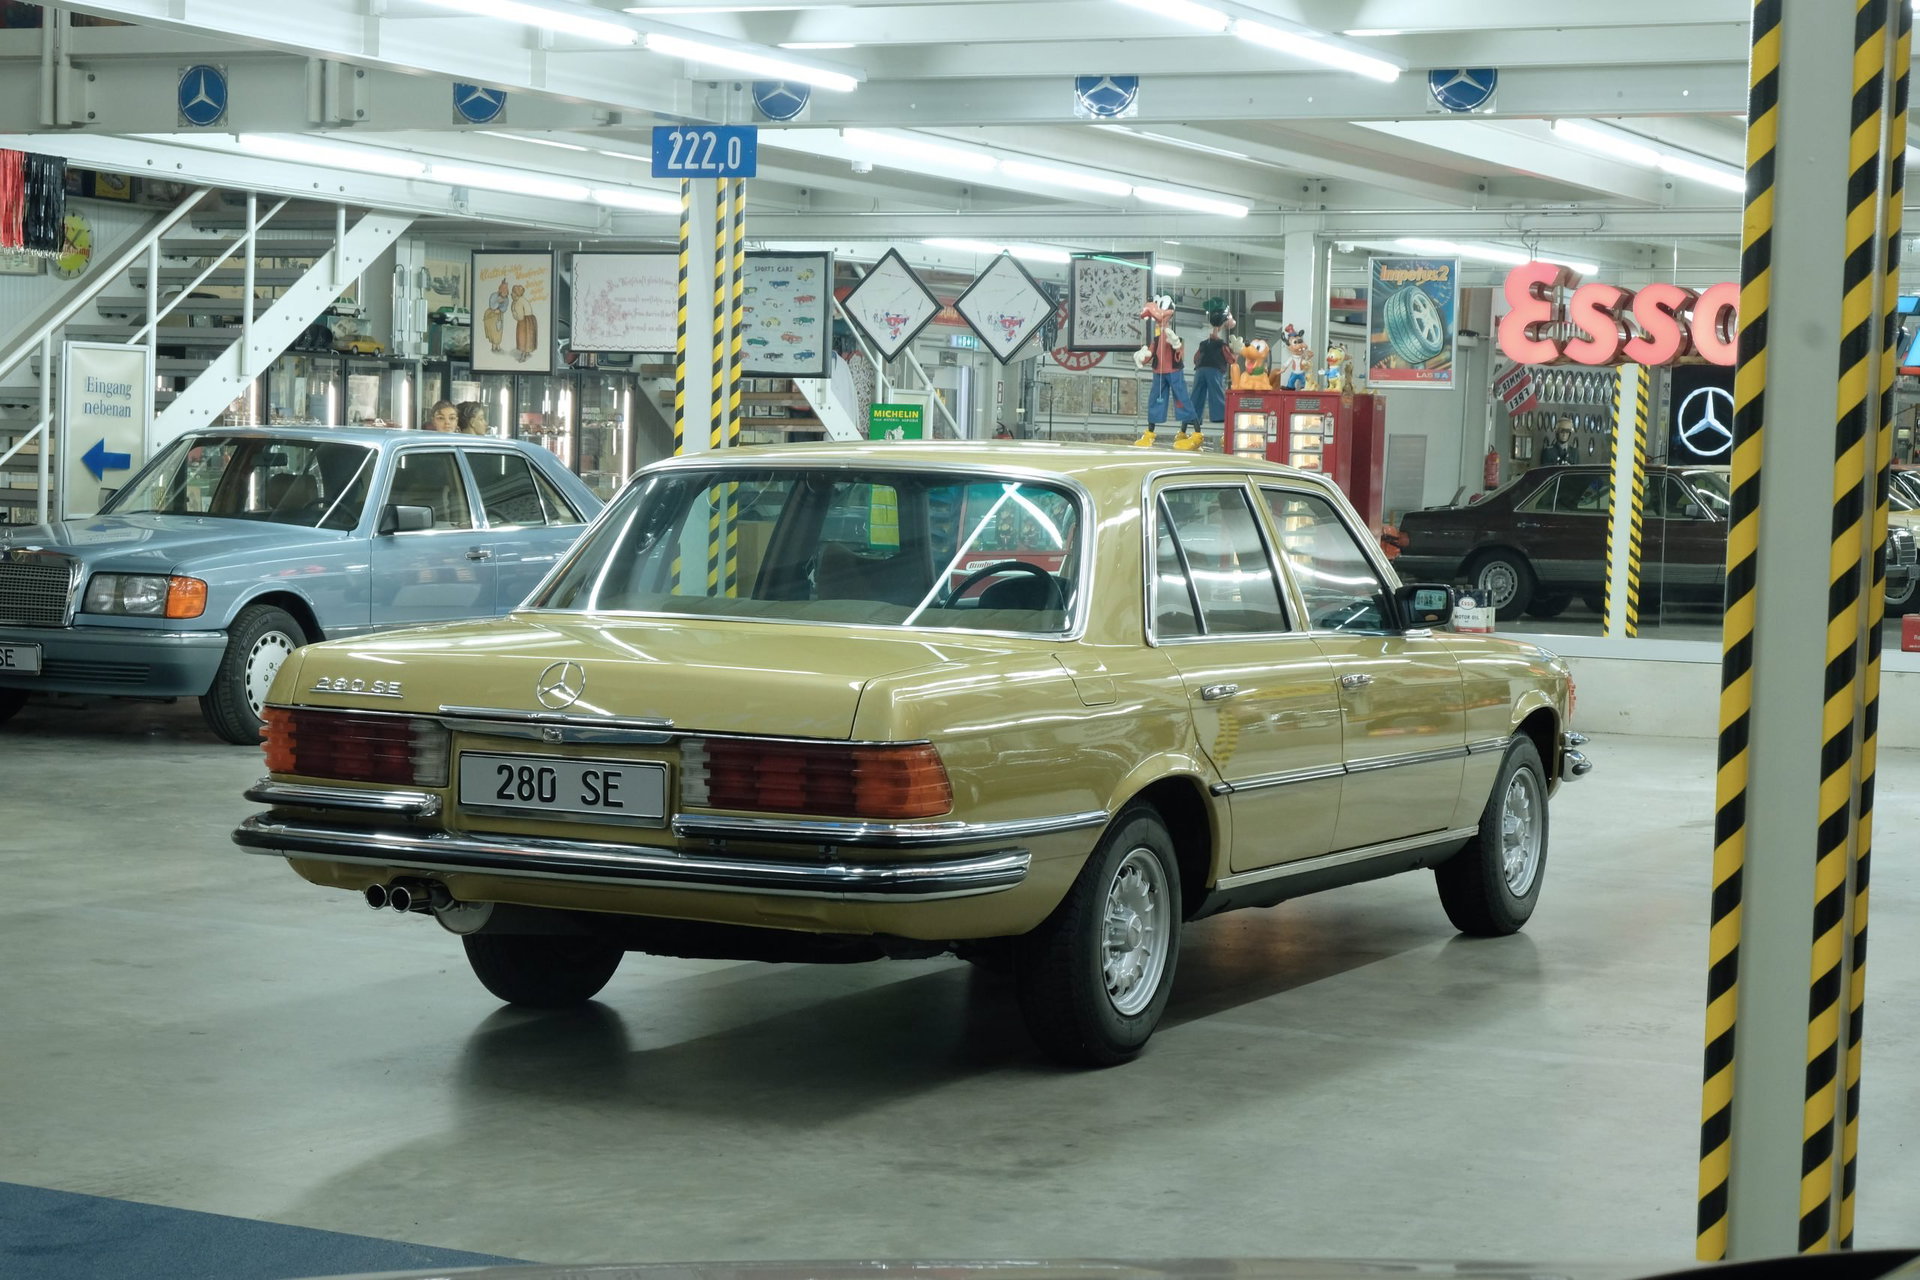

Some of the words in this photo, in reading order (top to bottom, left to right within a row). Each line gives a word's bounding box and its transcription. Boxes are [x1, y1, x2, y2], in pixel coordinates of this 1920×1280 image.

[667, 131, 741, 173] 222,0
[87, 376, 132, 400] Eingang
[84, 400, 131, 417] nebenan
[873, 410, 919, 418] MICHELIN
[315, 675, 366, 692] 280
[370, 679, 403, 695] SE
[496, 764, 557, 803] 280
[580, 770, 624, 808] SE
